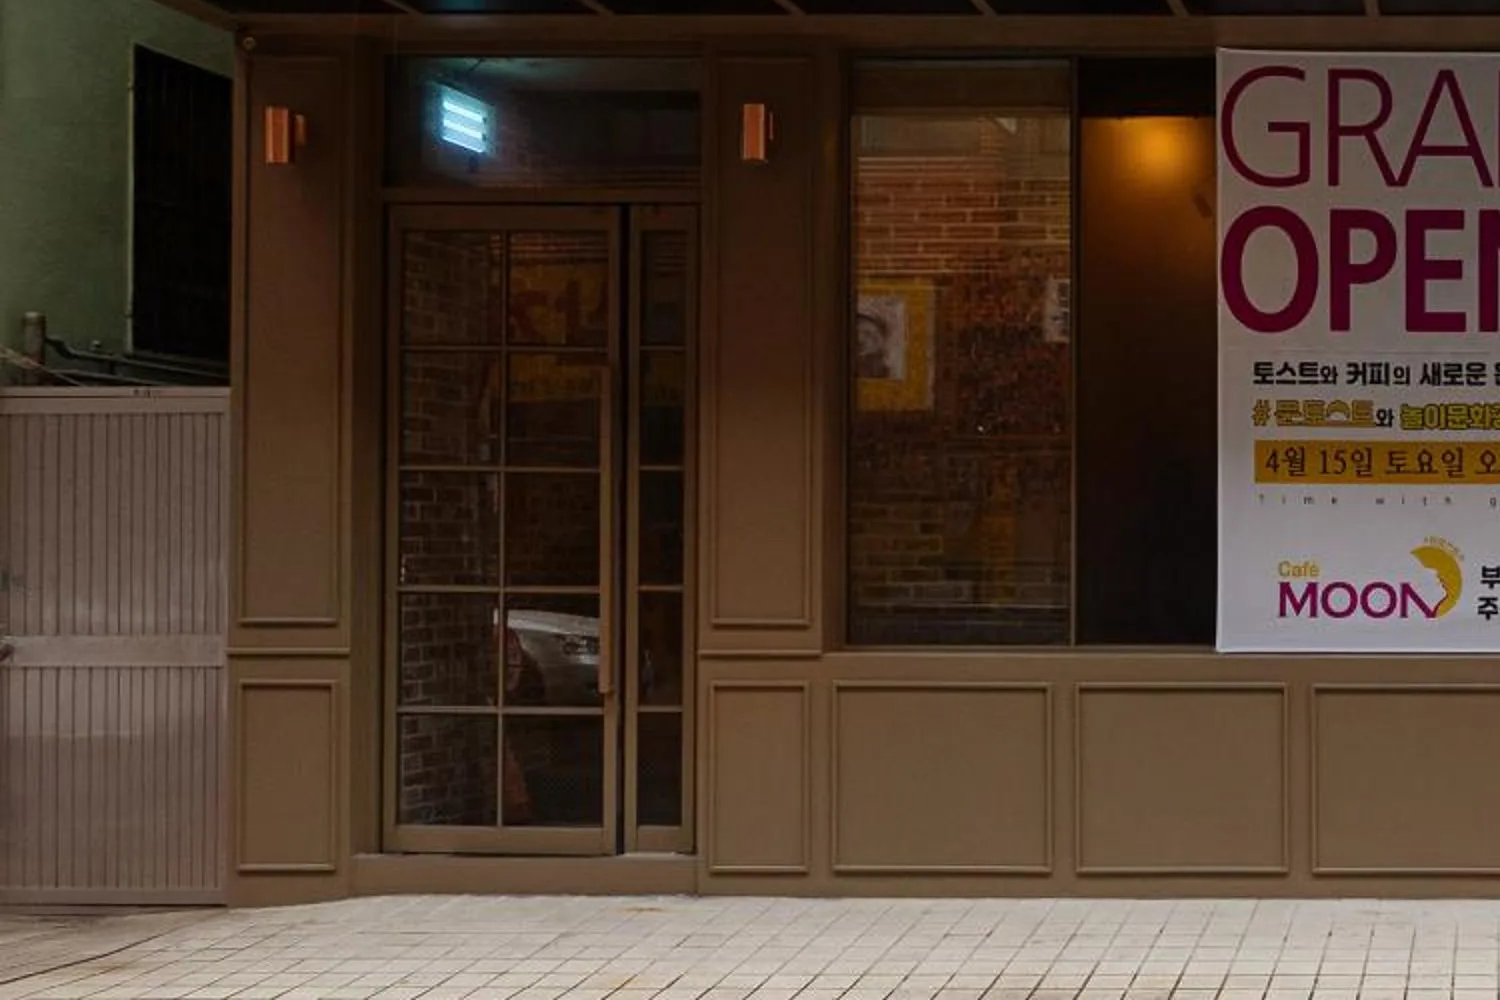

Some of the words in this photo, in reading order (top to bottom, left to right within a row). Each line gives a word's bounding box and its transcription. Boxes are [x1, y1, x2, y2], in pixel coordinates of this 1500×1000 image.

[1253, 361, 1338, 386] 토스트와
[1346, 361, 1411, 386] 커피의
[1419, 361, 1487, 386] 새로운
[1265, 447, 1306, 477] 4월
[1319, 447, 1374, 477] 15일
[1385, 448, 1464, 479] 토요일
[1278, 581, 1445, 619] MOON
